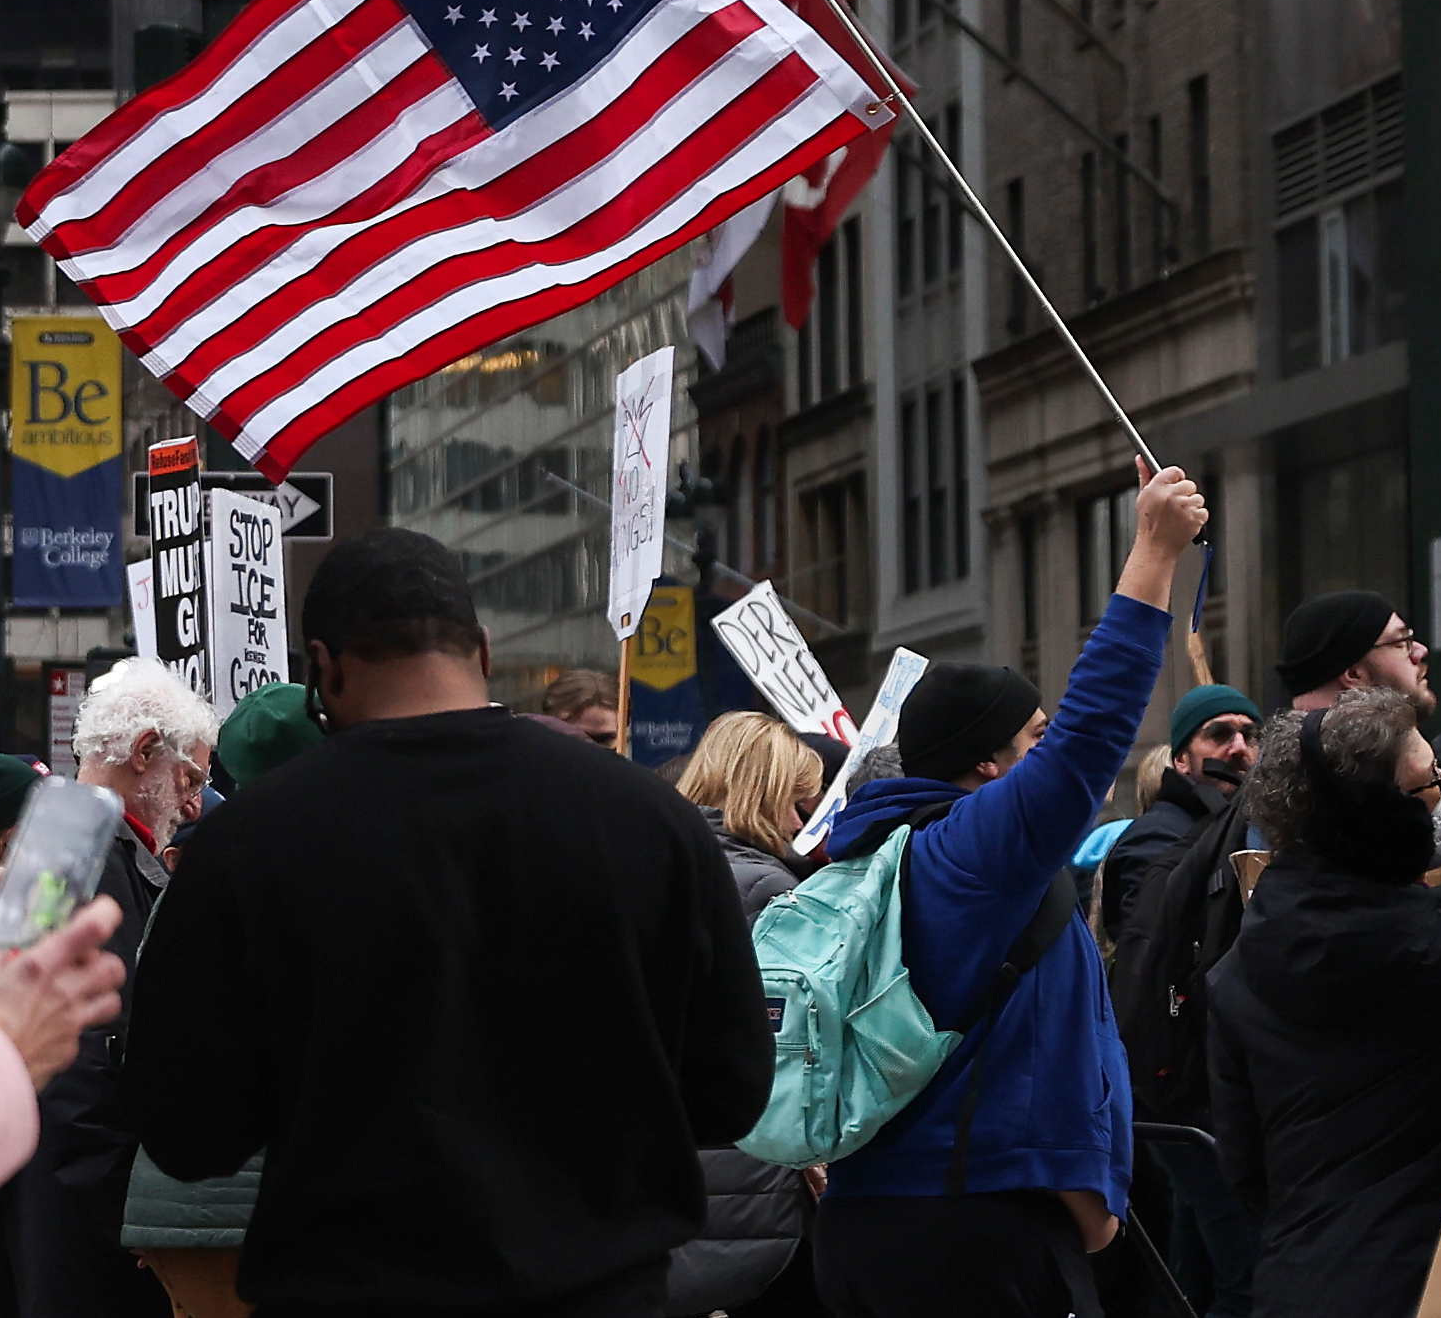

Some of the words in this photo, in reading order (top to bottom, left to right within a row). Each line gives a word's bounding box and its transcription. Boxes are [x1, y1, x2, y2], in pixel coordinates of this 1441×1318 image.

[22, 360, 111, 426] Be
[40, 526, 114, 549] Berkeley
[44, 545, 110, 569] College
[229, 508, 274, 566] STOP
[231, 562, 277, 620] ICE
[247, 617, 271, 650] FOR
[637, 615, 688, 658] Be
